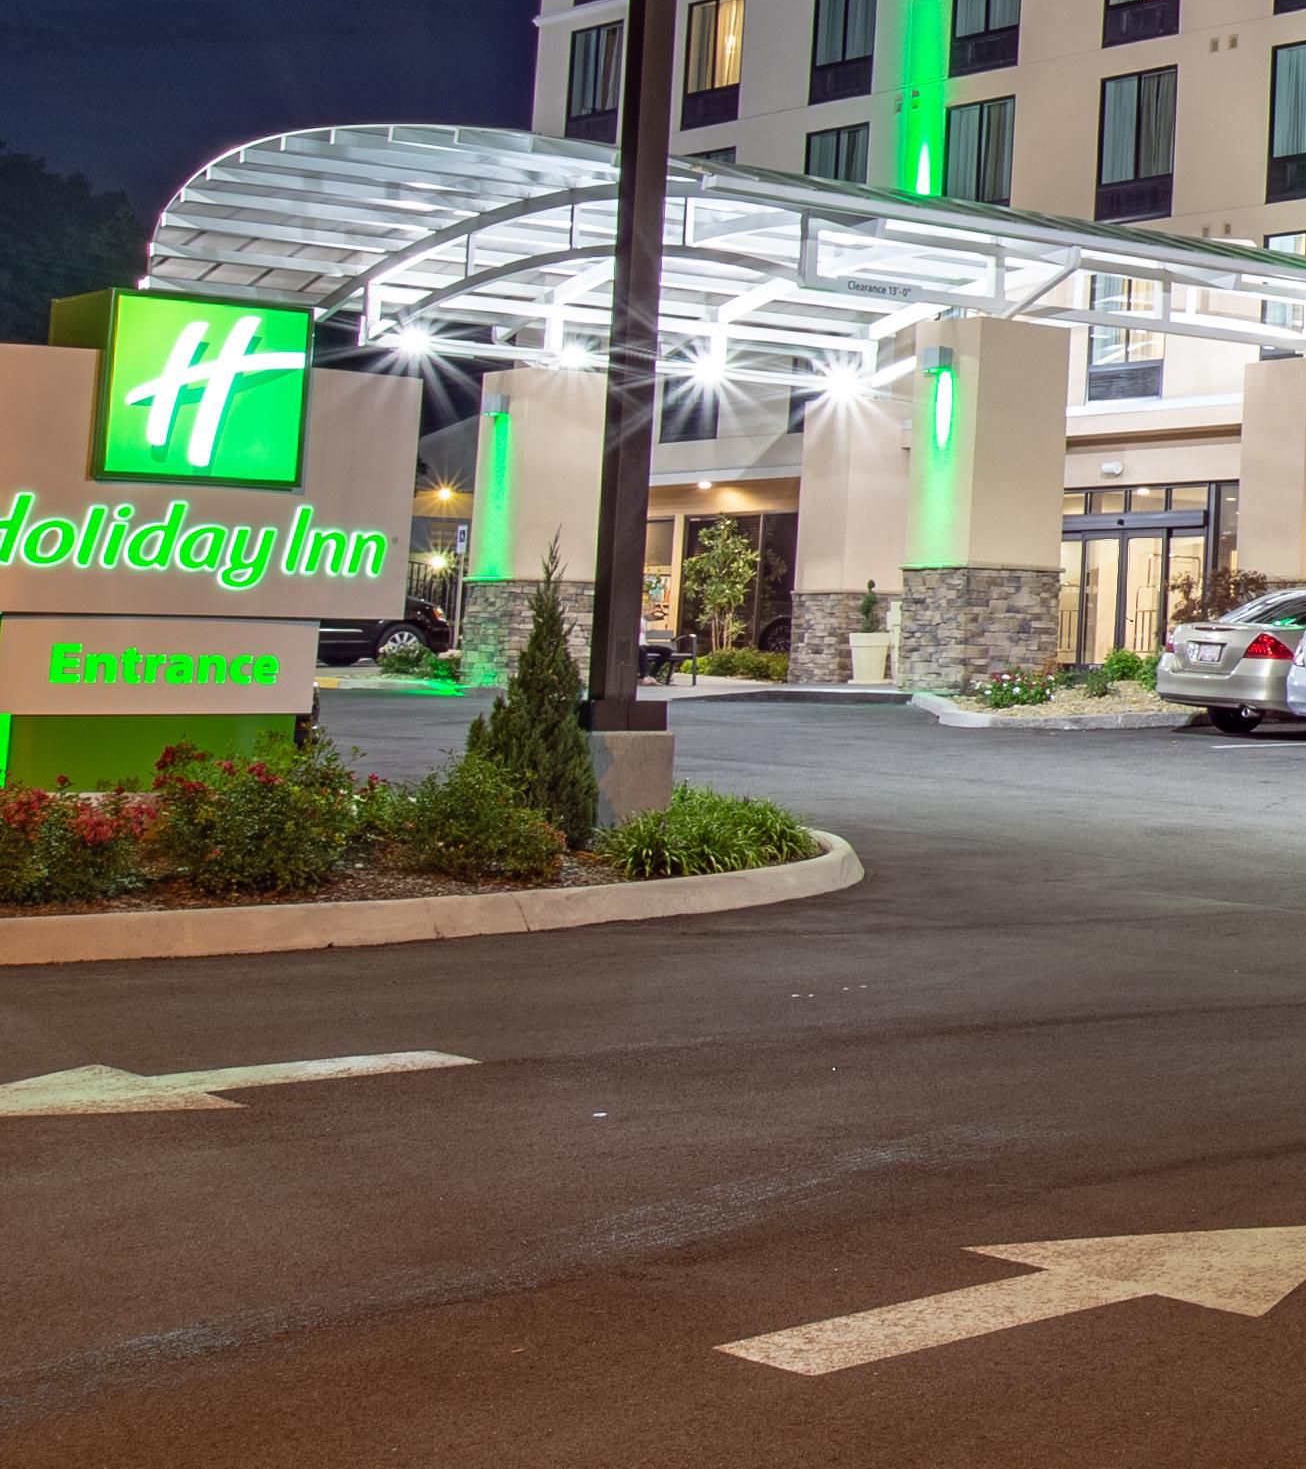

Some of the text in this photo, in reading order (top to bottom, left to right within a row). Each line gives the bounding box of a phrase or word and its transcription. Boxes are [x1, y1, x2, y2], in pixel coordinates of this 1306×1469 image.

[847, 280, 887, 295] Clearance
[281, 505, 388, 578] Inn
[48, 643, 280, 684] Entrance
